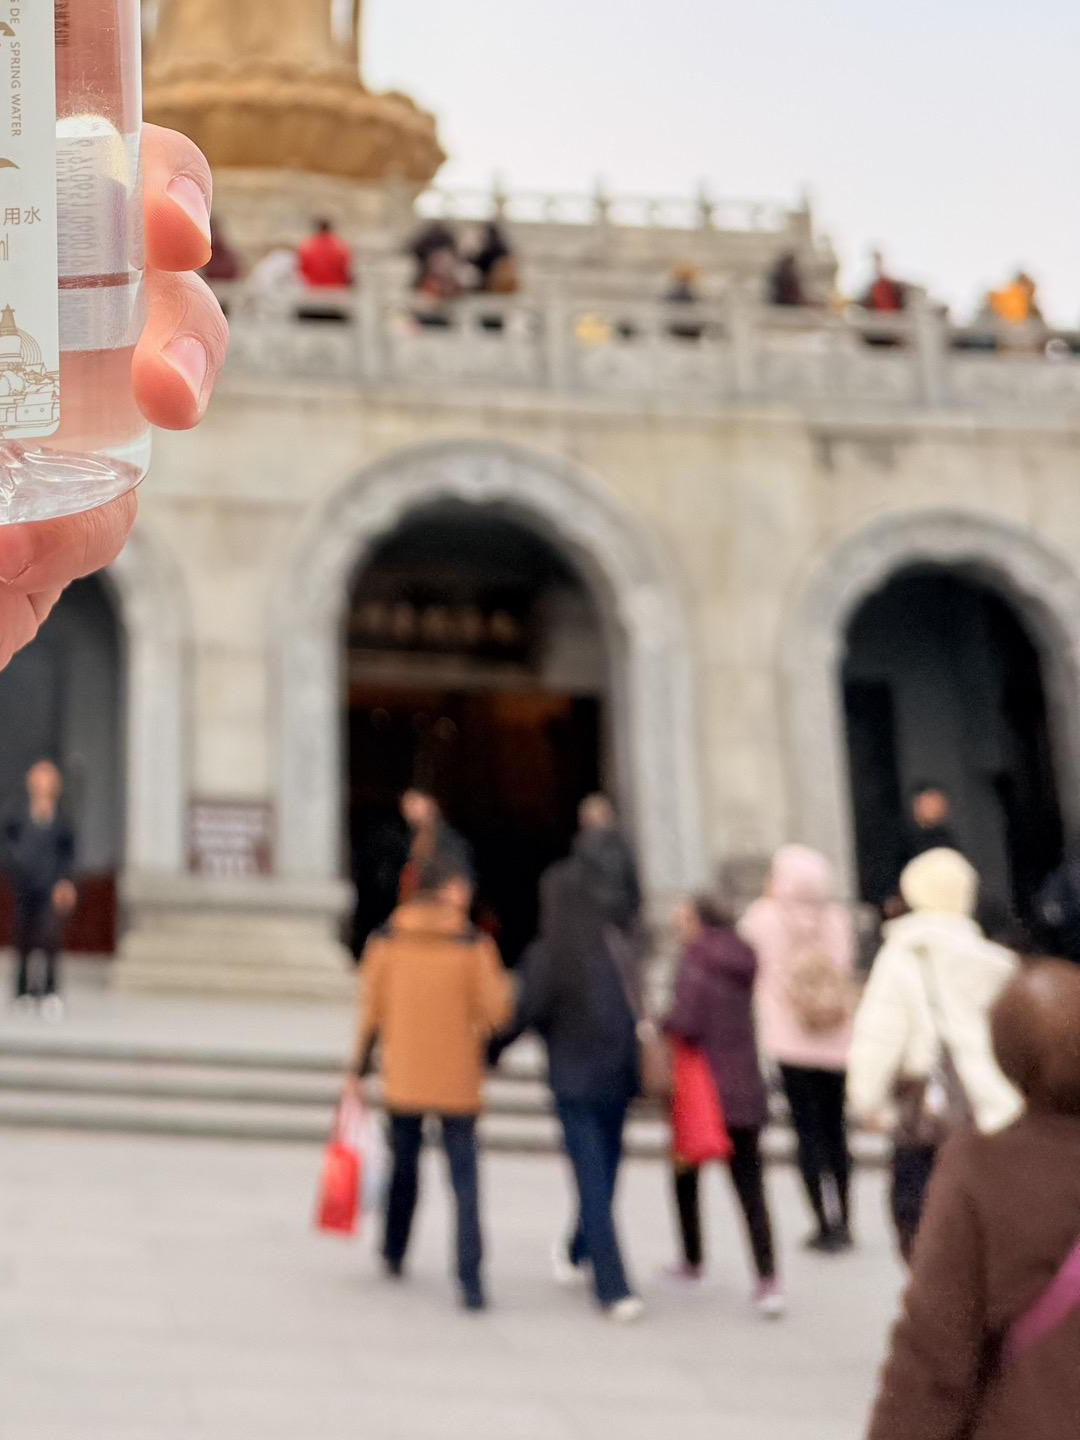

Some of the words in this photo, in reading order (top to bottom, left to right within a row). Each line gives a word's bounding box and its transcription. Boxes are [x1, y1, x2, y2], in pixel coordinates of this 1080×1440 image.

[10, 8, 20, 24] DE
[10, 41, 21, 89] SPRING
[11, 94, 22, 137] WATER
